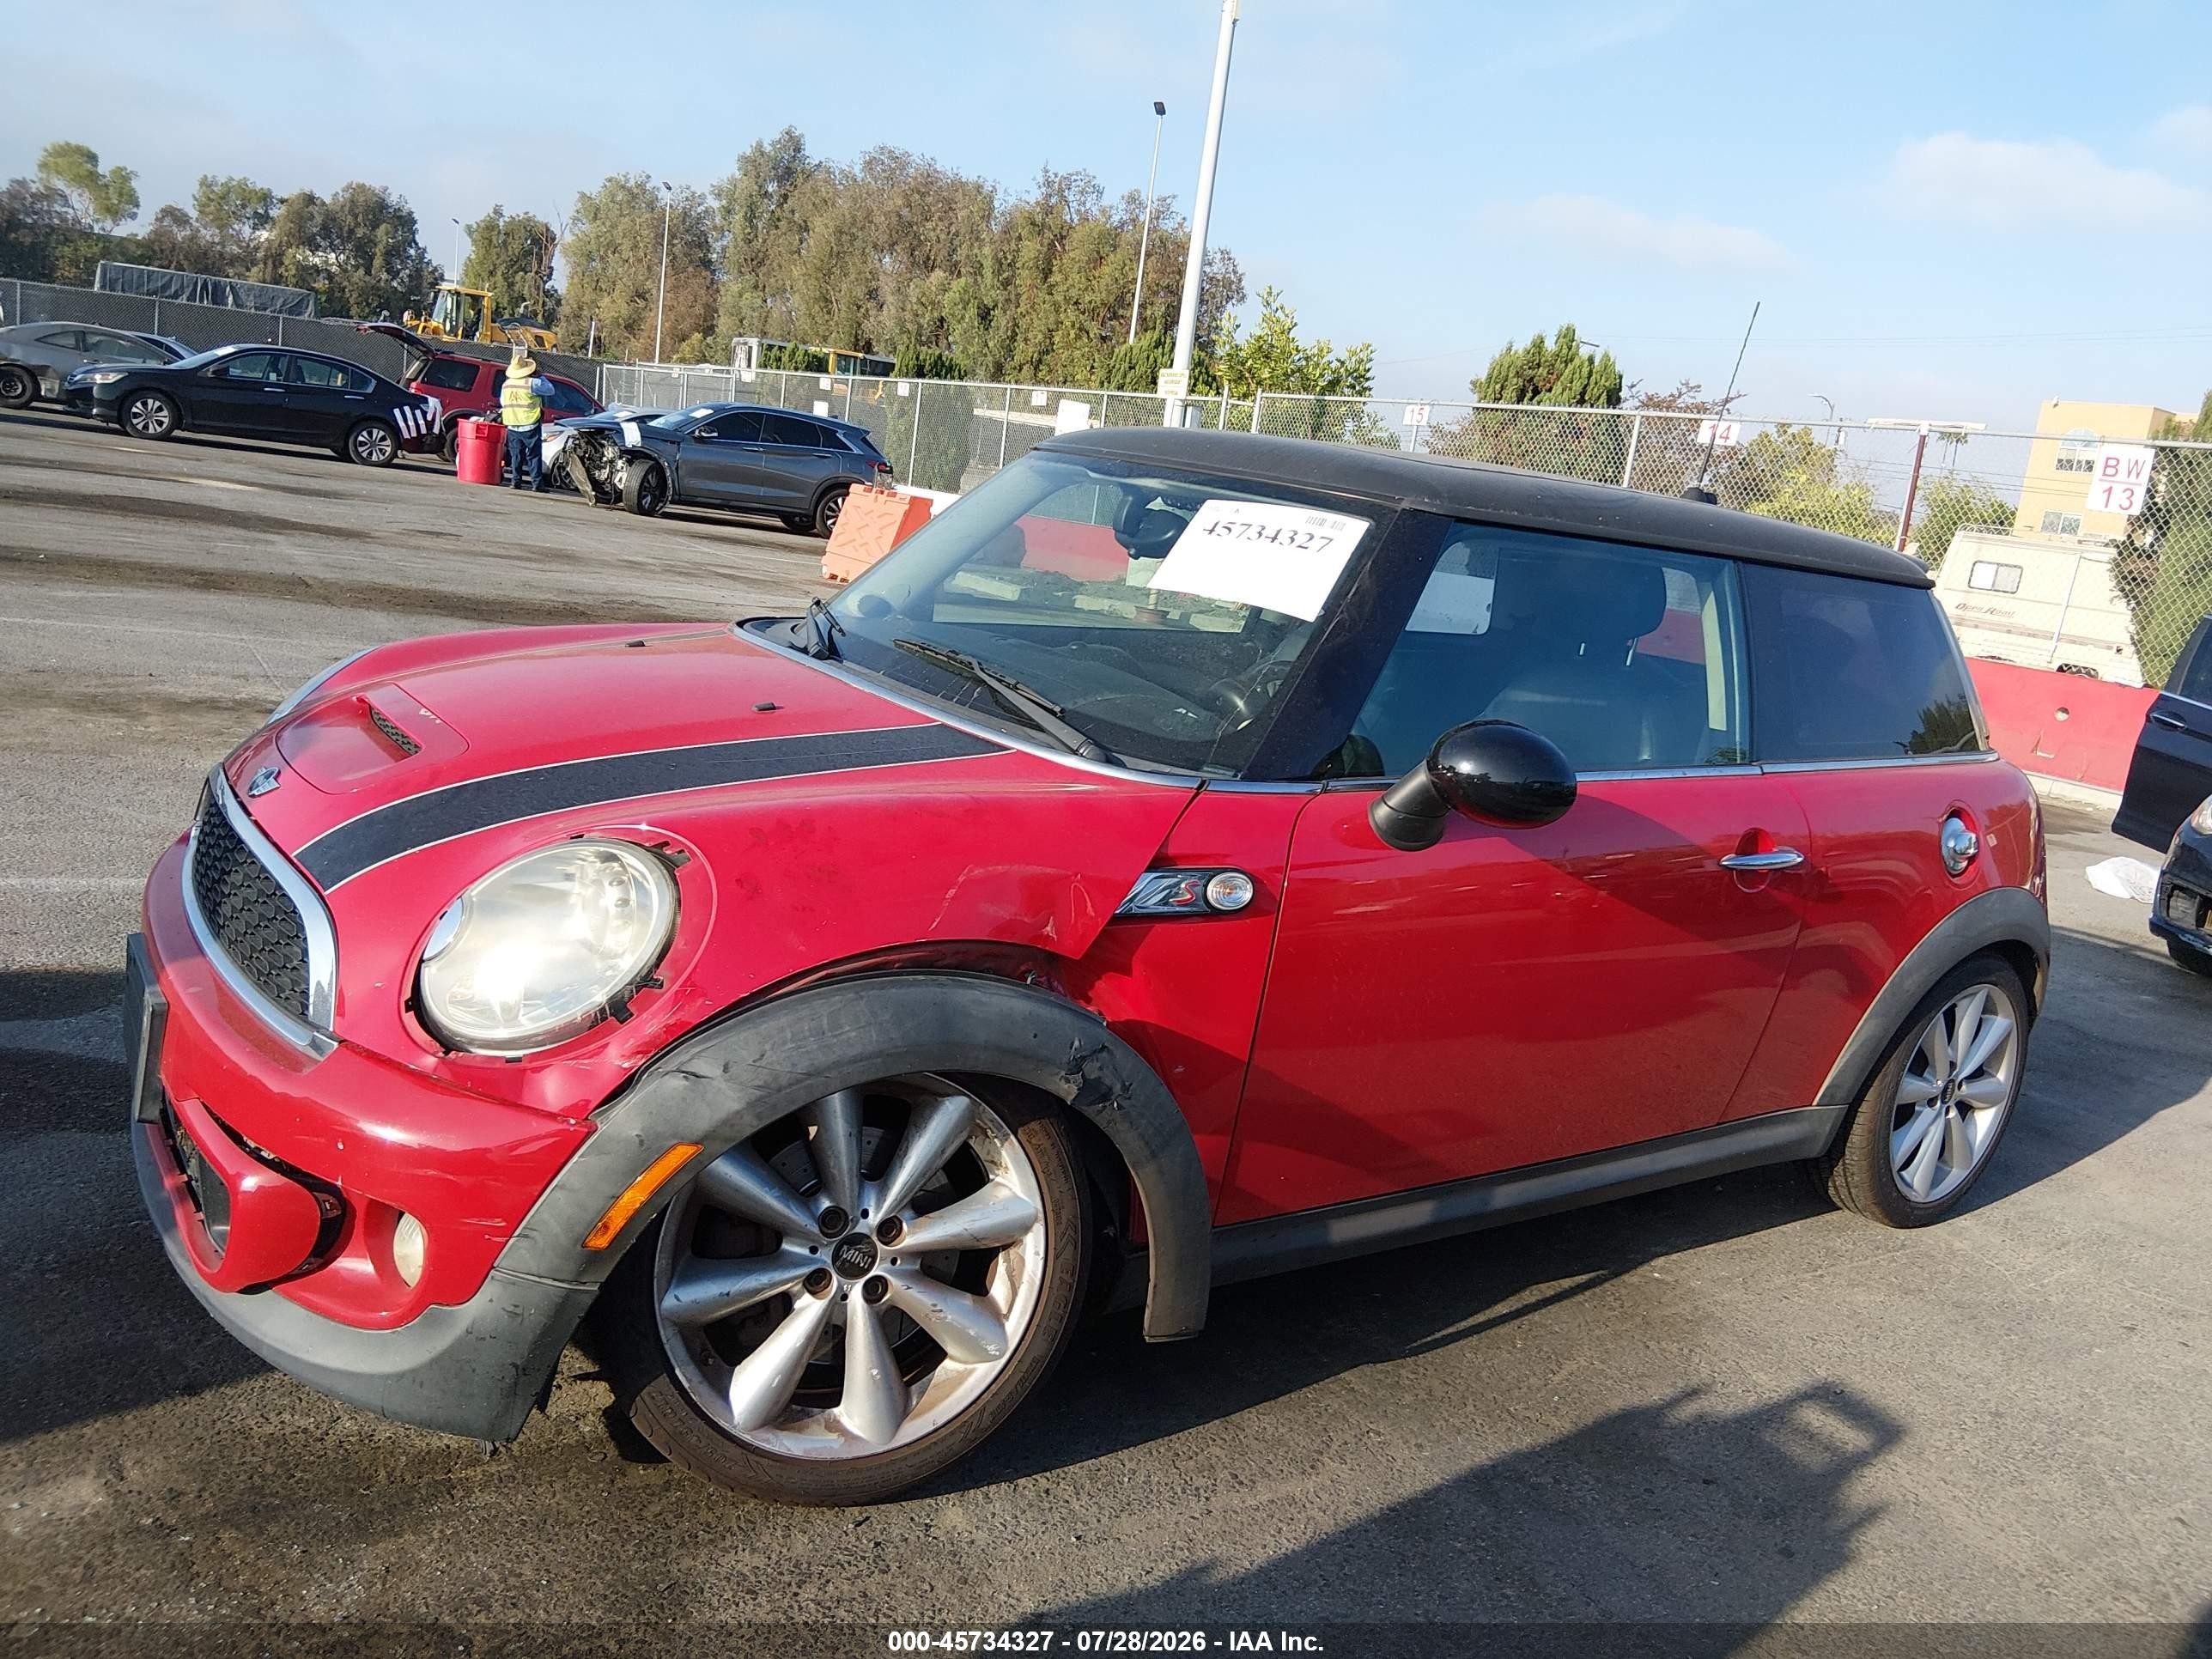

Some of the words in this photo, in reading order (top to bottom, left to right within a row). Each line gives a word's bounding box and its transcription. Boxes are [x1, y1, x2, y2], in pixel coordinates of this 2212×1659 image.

[1410, 407, 1425, 423] 15
[1709, 423, 1732, 443] 14
[2102, 485, 2135, 511] 13
[1203, 520, 1334, 553] 45734327
[839, 1244, 872, 1269] MINI
[1042, 1262, 1075, 1342] EAGLE
